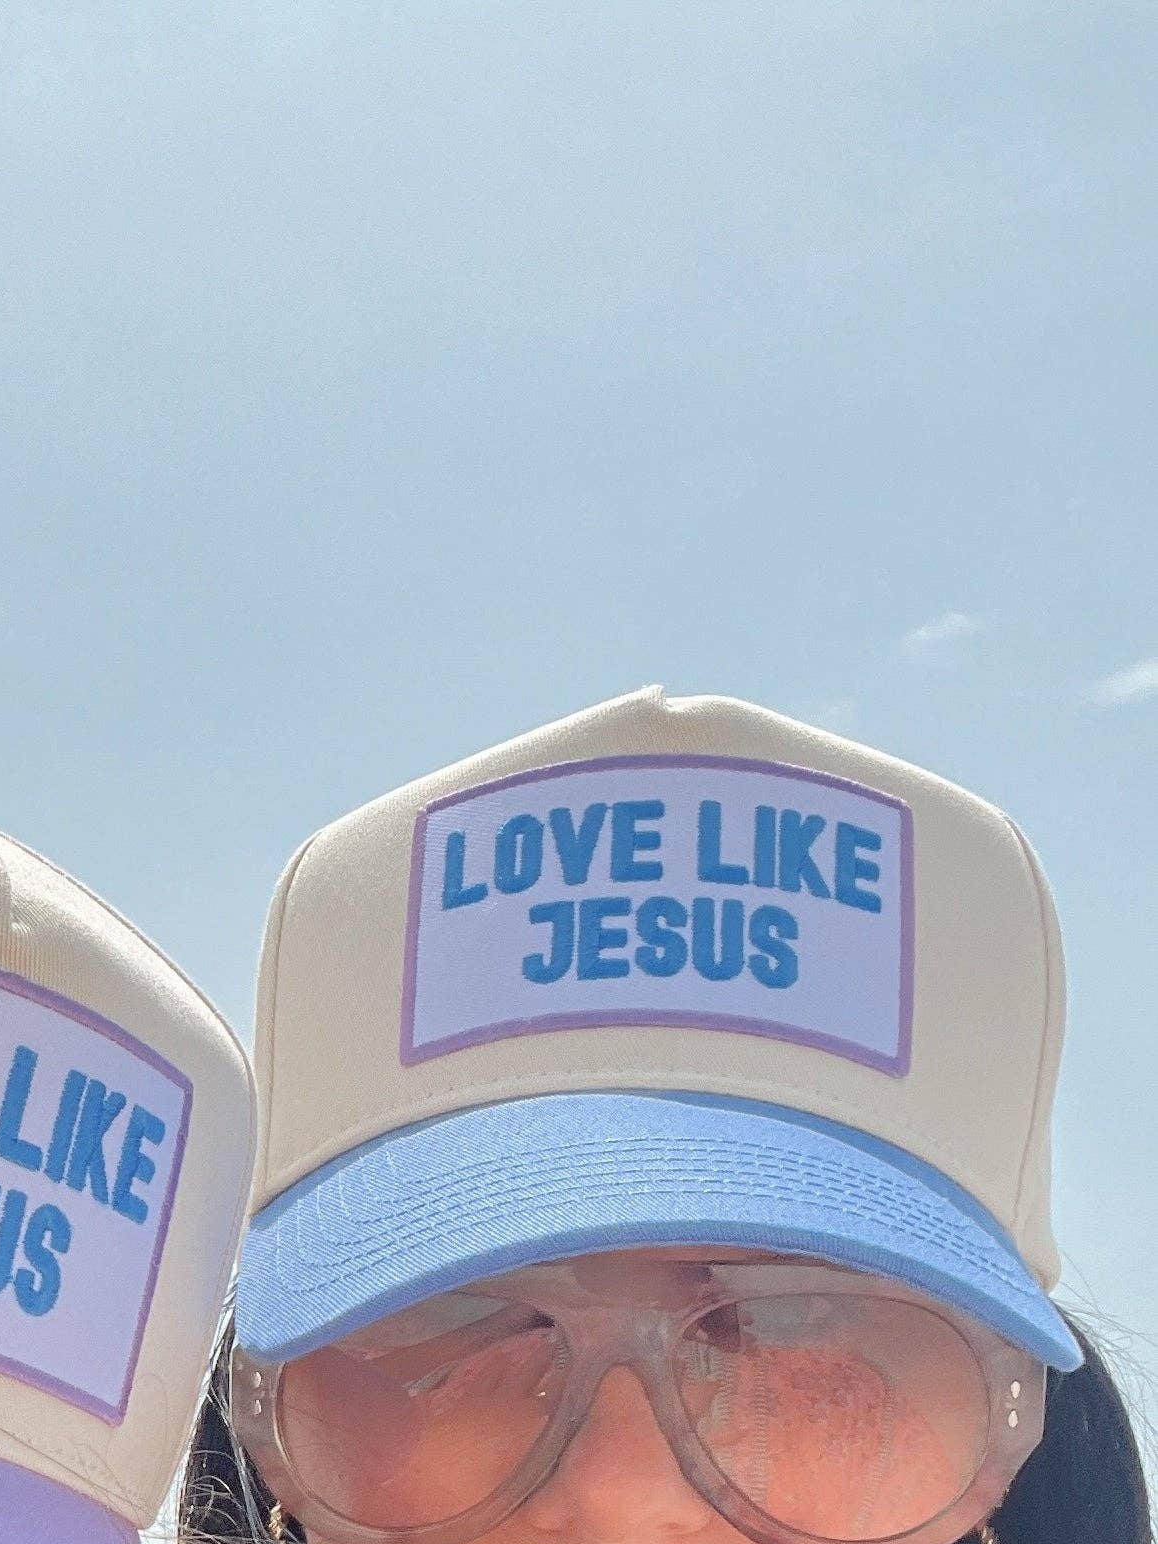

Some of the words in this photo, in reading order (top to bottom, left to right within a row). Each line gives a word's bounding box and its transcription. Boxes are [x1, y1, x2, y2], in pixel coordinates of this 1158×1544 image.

[442, 800, 665, 911] LOVE
[698, 800, 882, 913] LIKE
[522, 896, 799, 989] JESUS
